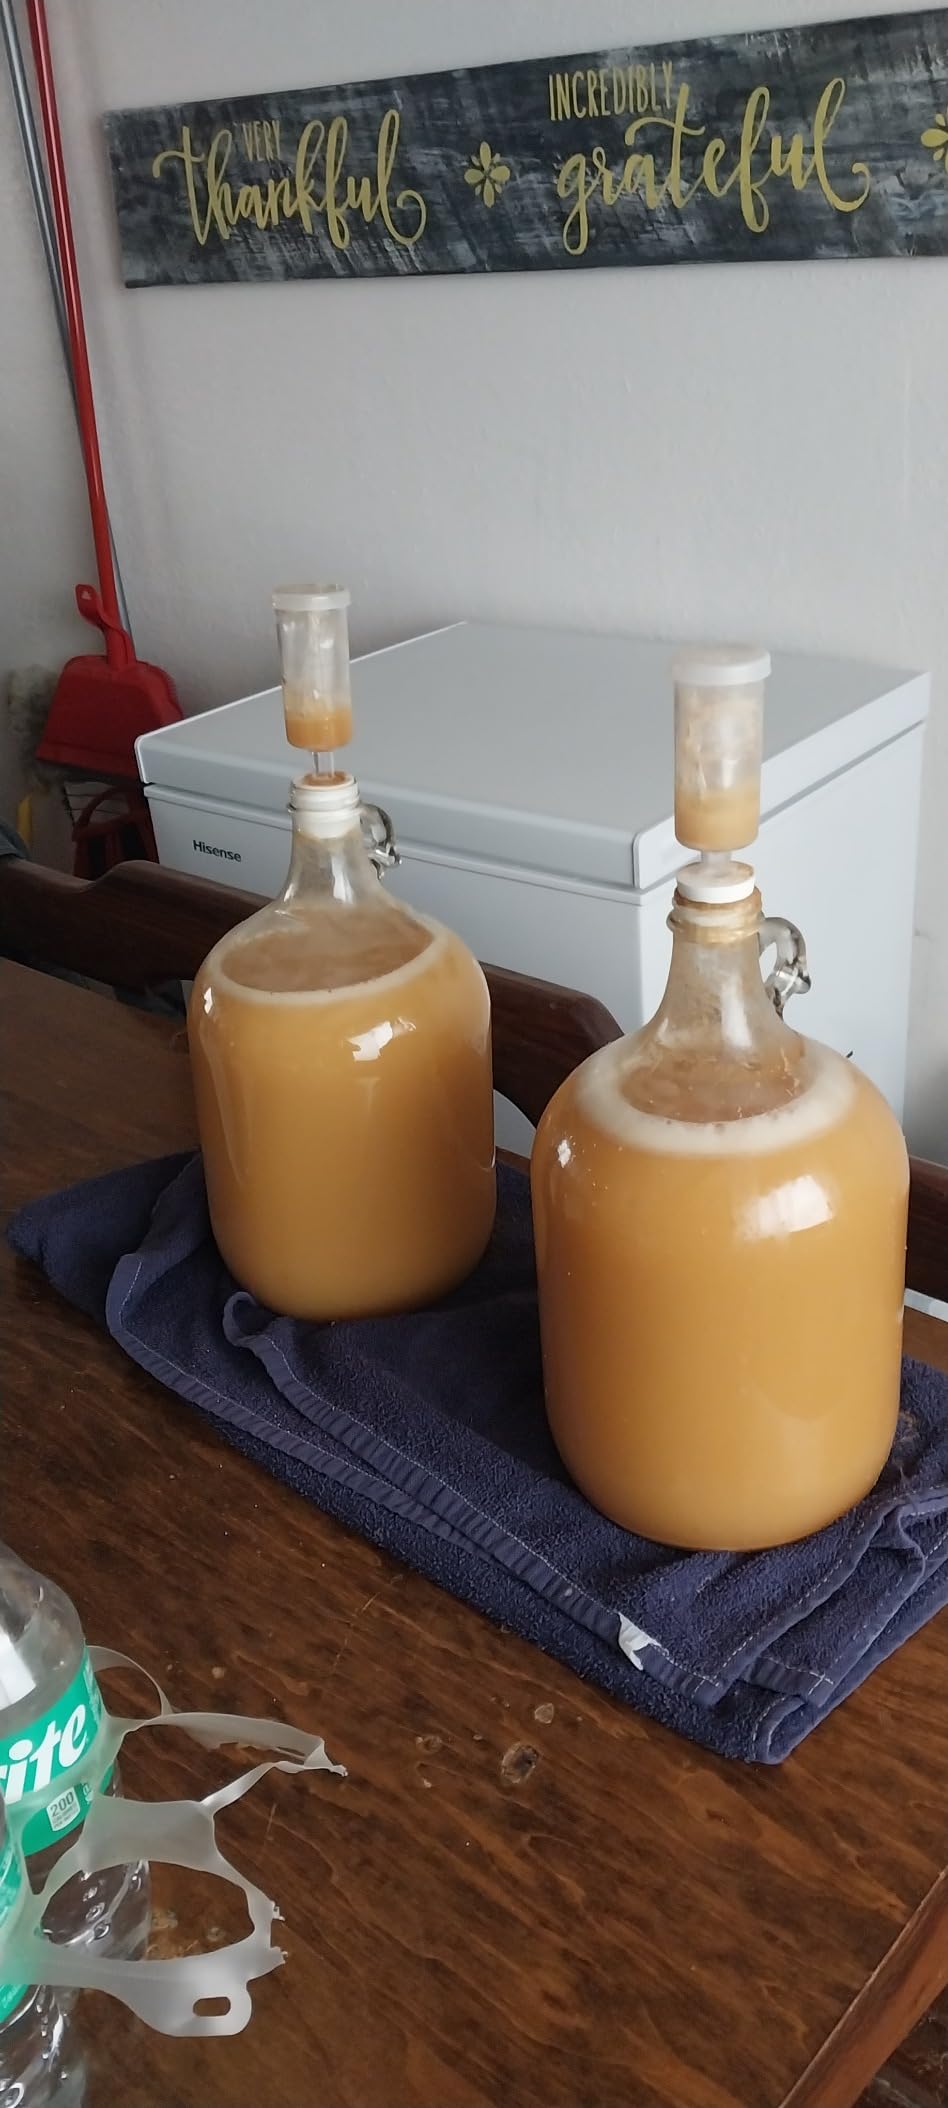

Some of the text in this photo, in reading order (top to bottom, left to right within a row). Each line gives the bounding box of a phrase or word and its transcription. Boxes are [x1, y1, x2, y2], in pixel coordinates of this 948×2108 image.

[548, 63, 674, 121] INCREDIBLY
[242, 120, 282, 161] VERY
[152, 109, 426, 250] thankful
[556, 77, 870, 256] grateful
[192, 840, 242, 862] Hisense
[50, 1792, 74, 1817] 200
